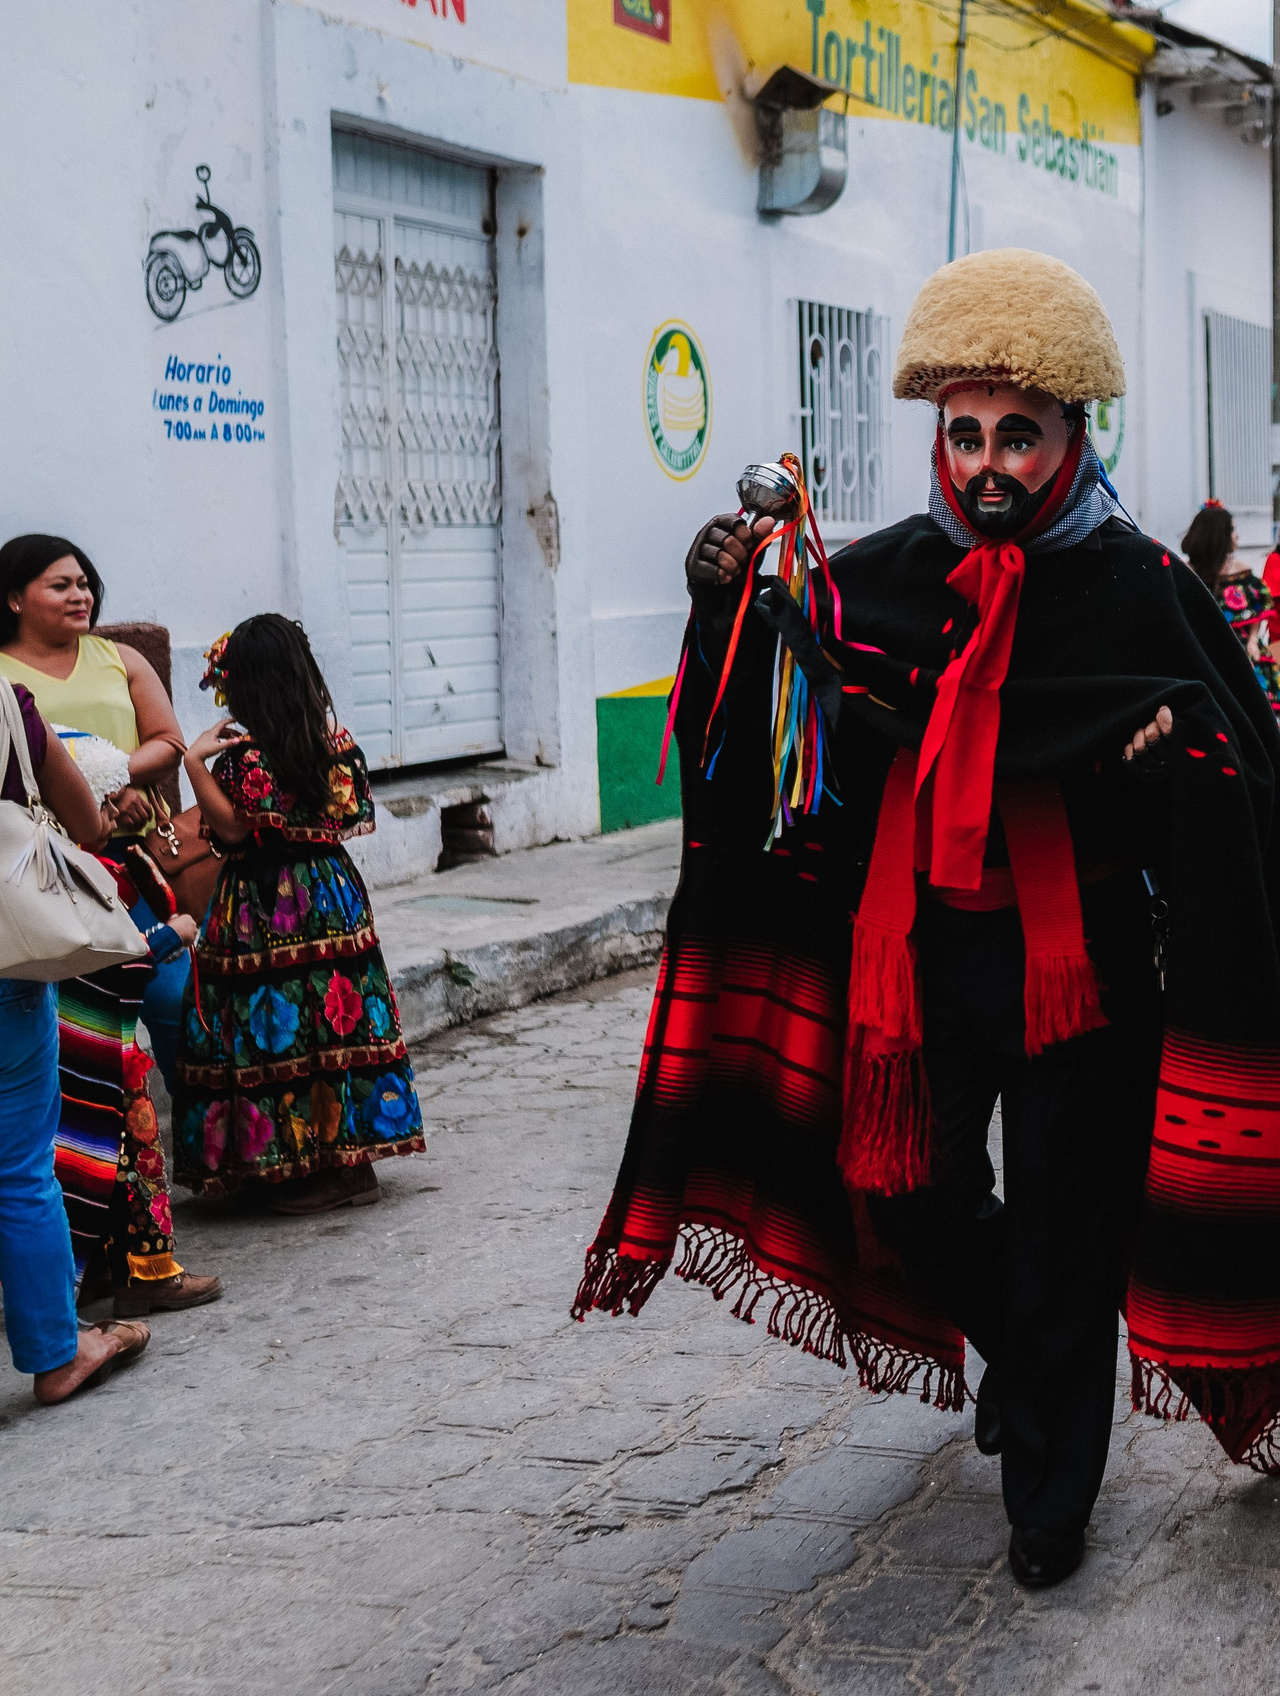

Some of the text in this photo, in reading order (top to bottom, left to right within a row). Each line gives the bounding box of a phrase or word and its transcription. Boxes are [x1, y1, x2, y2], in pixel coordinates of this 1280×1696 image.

[964, 68, 1006, 155] San
[165, 352, 231, 384] Horario
[193, 397, 202, 412] a
[208, 389, 264, 421] Domingo
[210, 422, 218, 440] A
